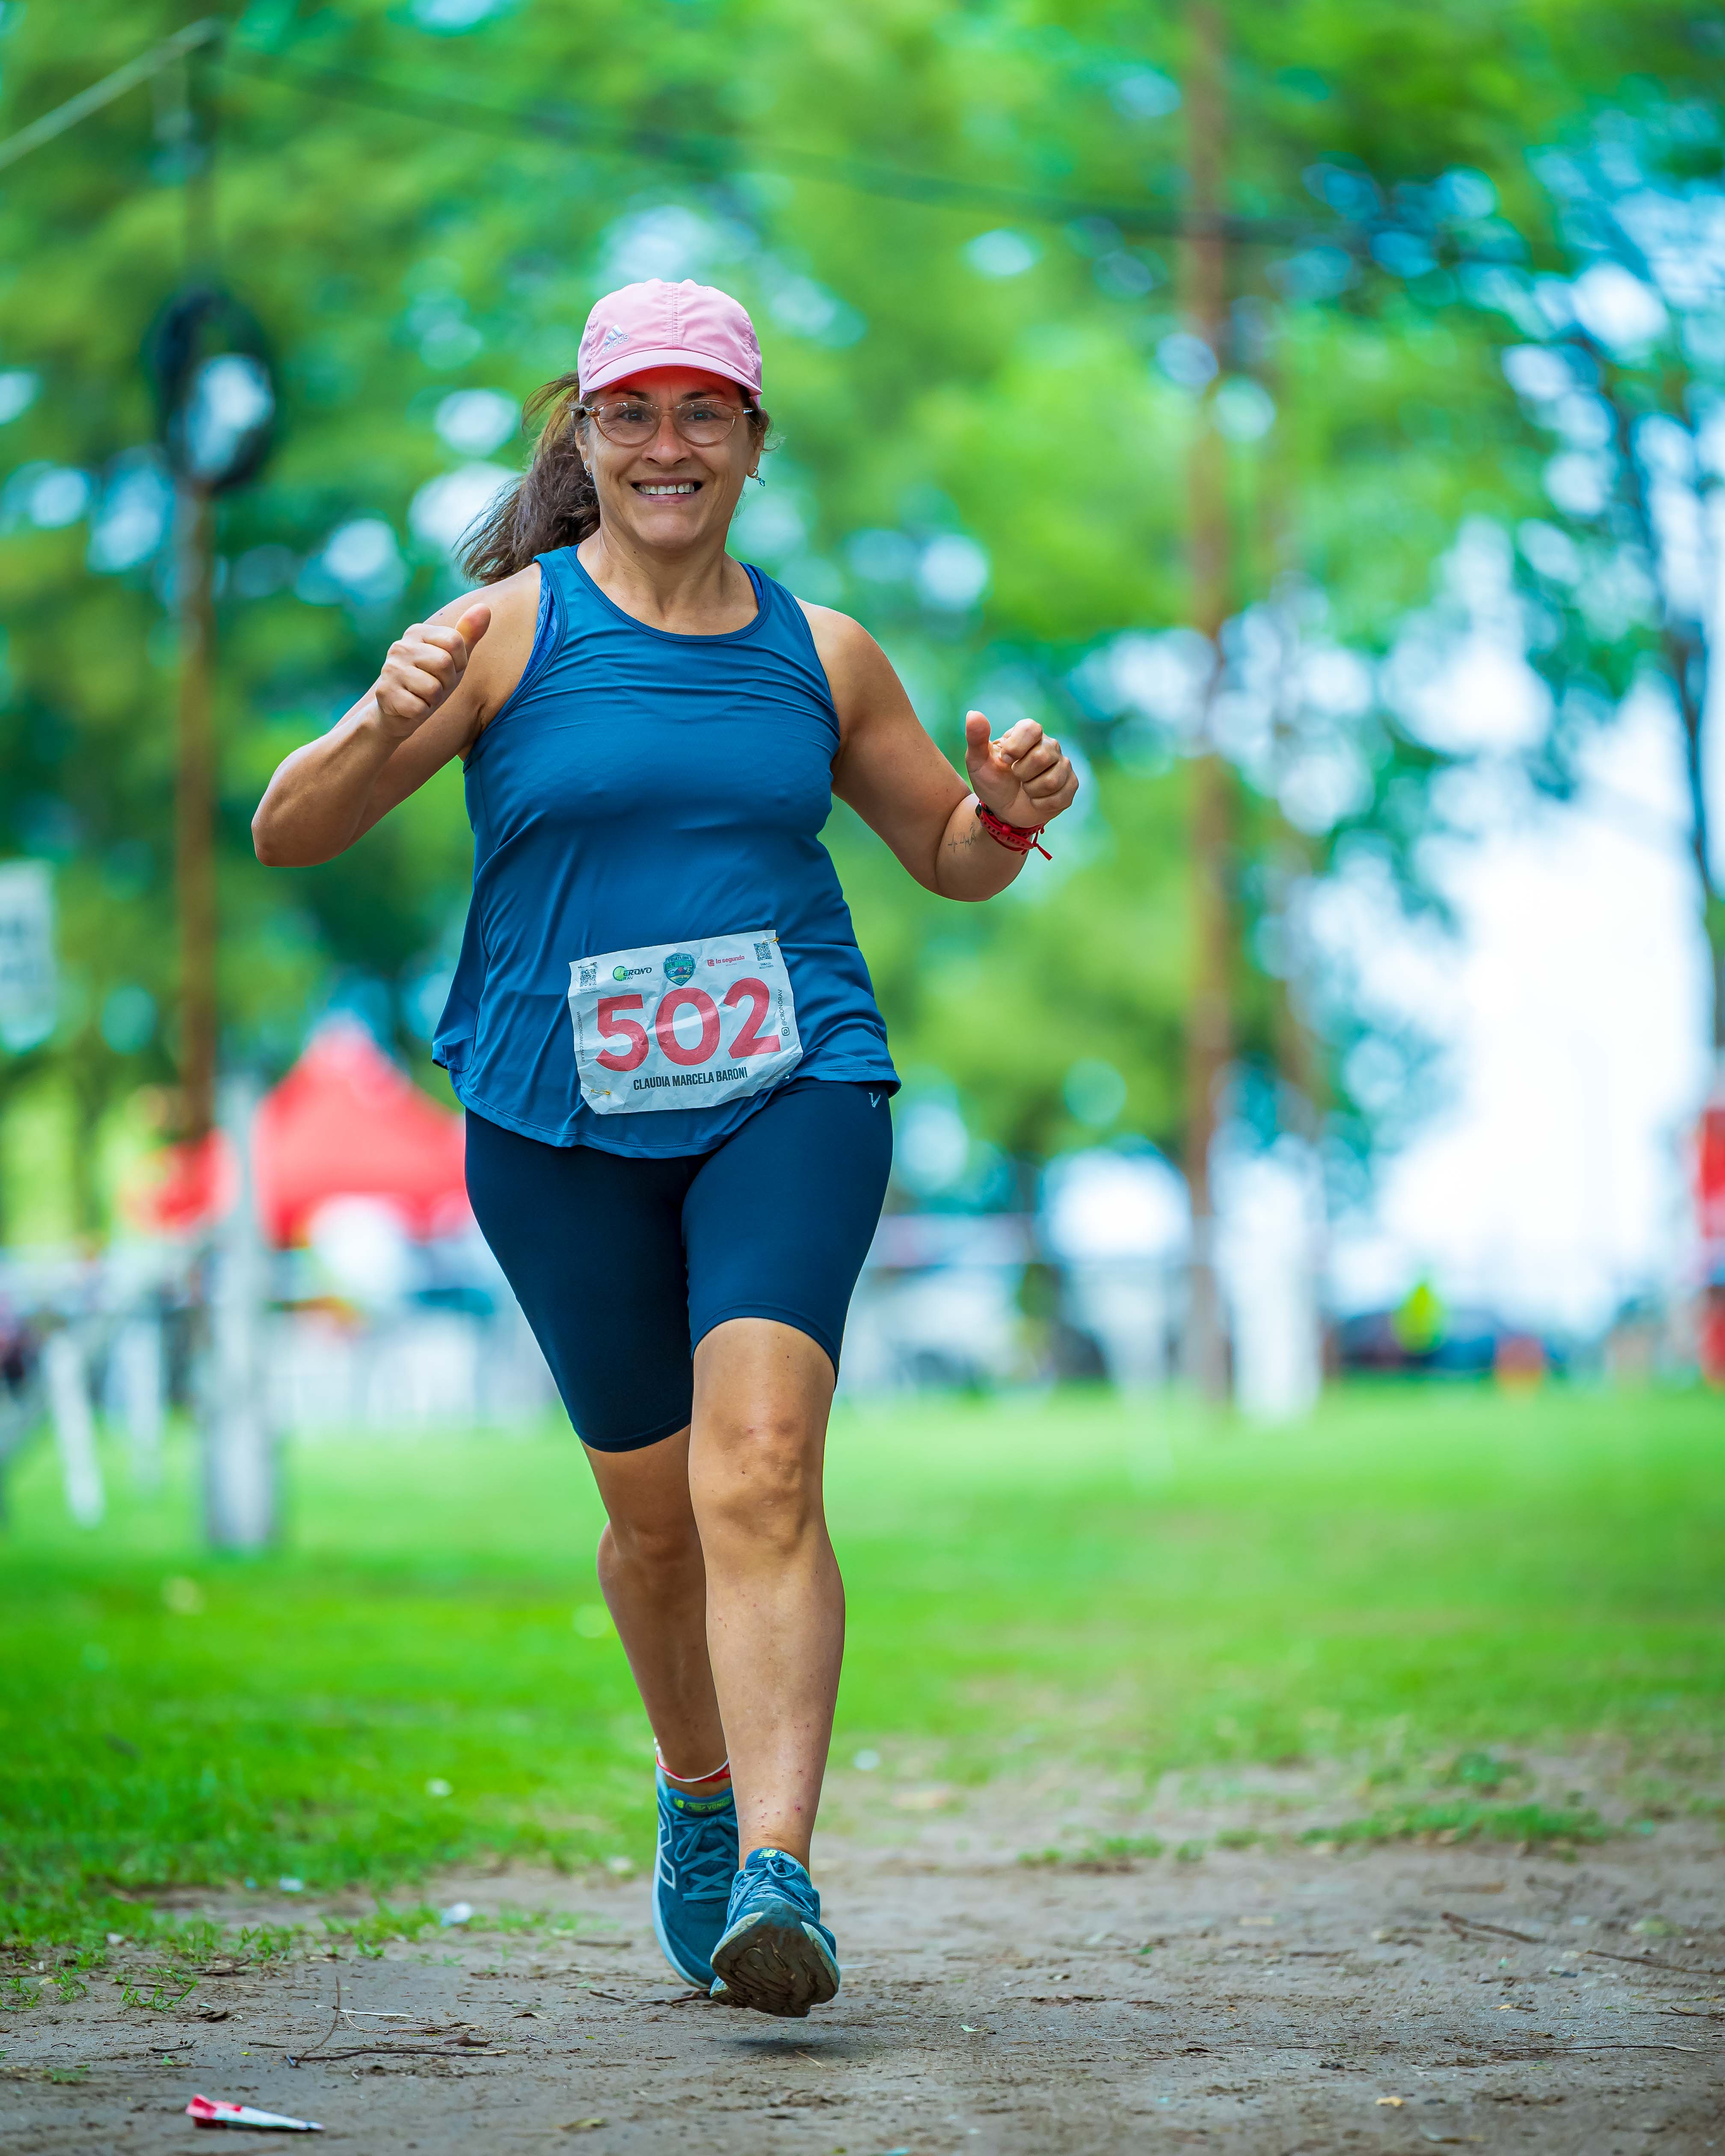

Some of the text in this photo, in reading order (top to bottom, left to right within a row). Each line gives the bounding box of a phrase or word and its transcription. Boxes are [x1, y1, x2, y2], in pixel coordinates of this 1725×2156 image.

[602, 334, 629, 354] adidas
[722, 955, 745, 963] segunda
[777, 989, 787, 1026] @CRONORAV
[596, 977, 781, 1072] 502
[633, 1067, 748, 1090] CLAUDIA MARCELA BARONI
